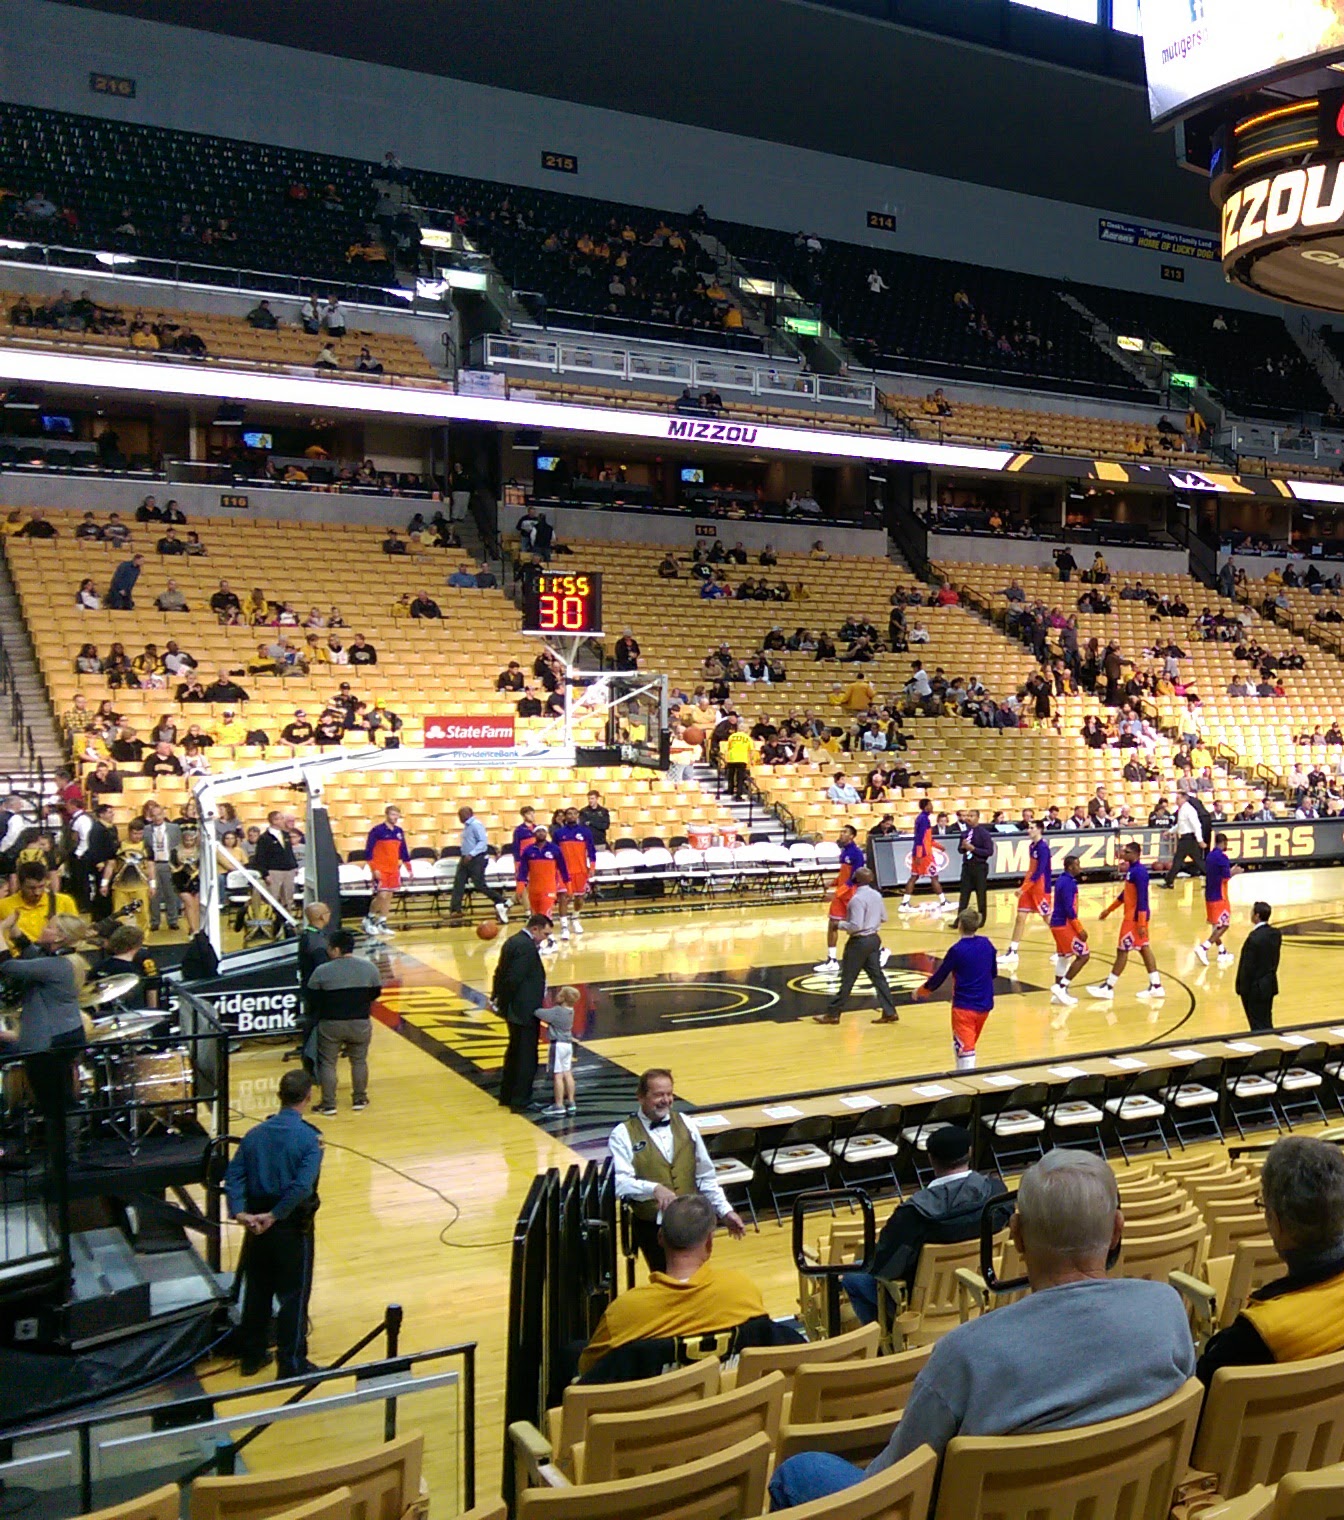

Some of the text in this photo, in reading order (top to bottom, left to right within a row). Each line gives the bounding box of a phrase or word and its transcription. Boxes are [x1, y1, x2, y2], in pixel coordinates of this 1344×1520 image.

[96, 76, 131, 94] 216
[545, 155, 574, 170] 215
[870, 215, 893, 228] 214
[1138, 237, 1160, 249] HOME
[1161, 242, 1171, 250] OF
[1172, 243, 1195, 255] LUCKY
[1179, 235, 1197, 246] Family
[1198, 239, 1212, 248] Land
[1164, 268, 1182, 279] 213
[668, 420, 757, 443] MIZZOU
[540, 577, 589, 595] 11:55
[540, 596, 582, 628] 30
[238, 1010, 297, 1032] Bank
